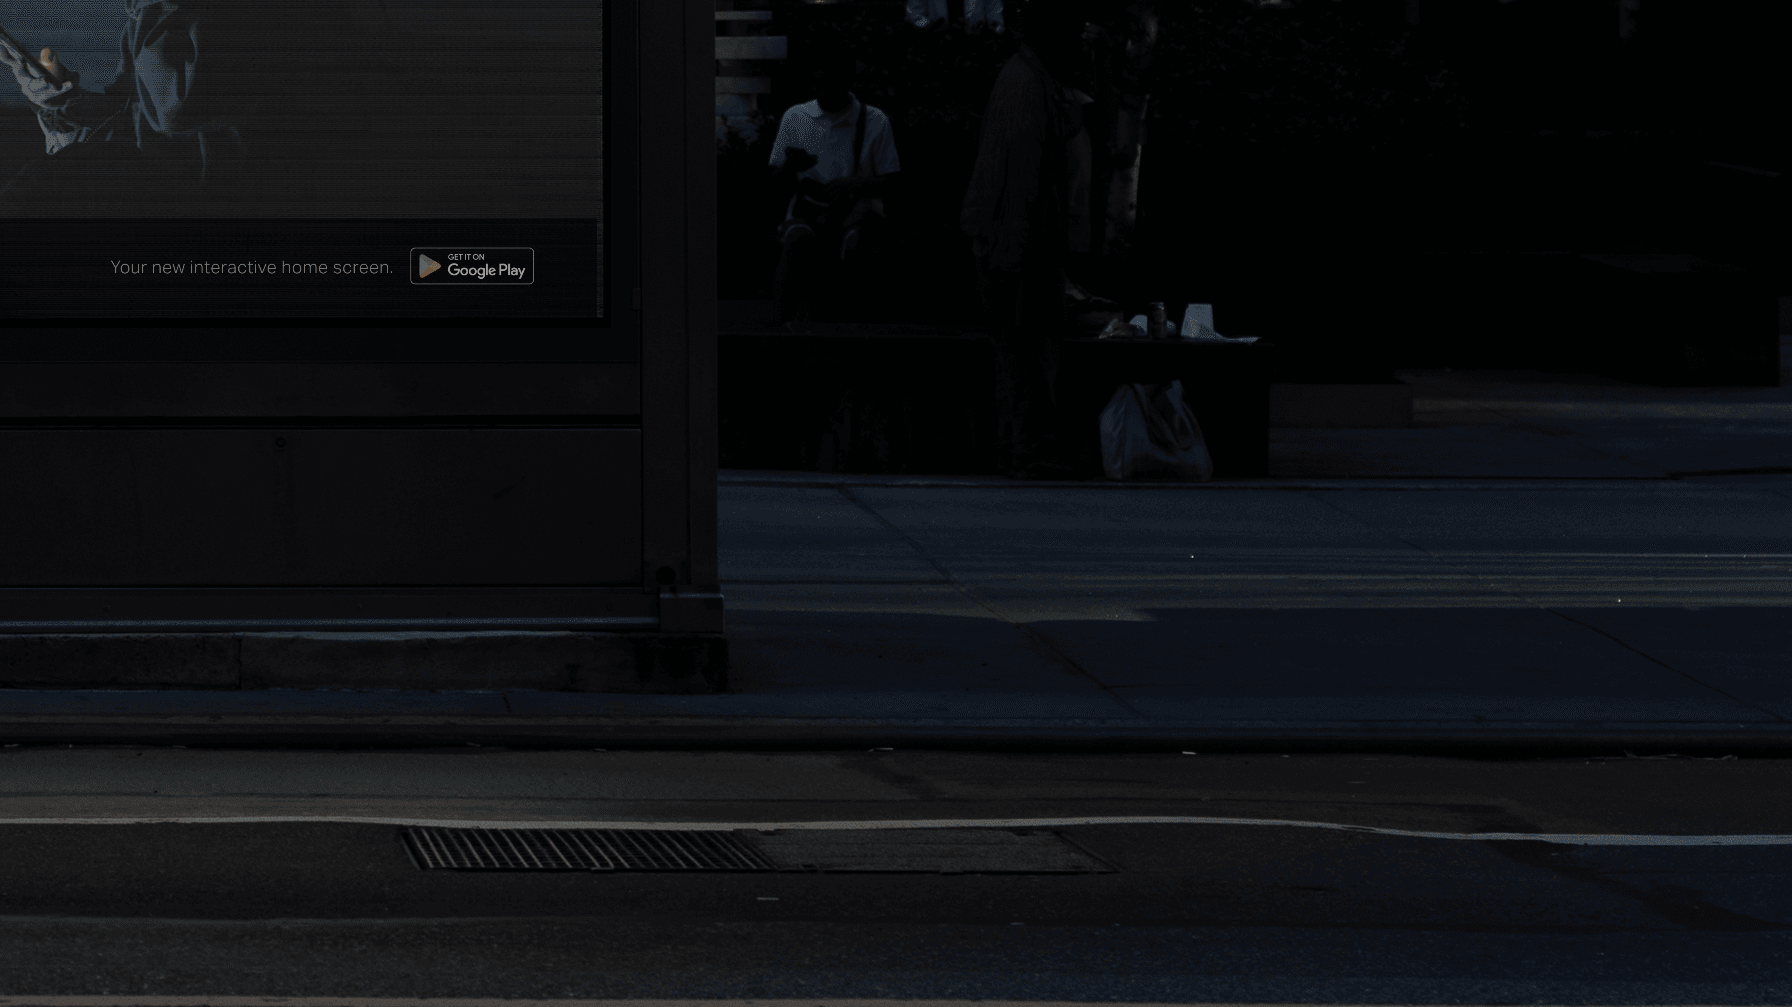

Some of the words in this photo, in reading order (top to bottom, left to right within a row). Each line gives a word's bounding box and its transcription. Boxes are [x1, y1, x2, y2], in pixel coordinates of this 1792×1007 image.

[447, 253, 463, 261] GET
[464, 253, 471, 261] IT
[472, 253, 485, 261] ON
[110, 261, 147, 275] Your
[152, 264, 186, 275] new
[190, 260, 277, 275] interactive
[282, 260, 328, 275] home
[333, 263, 394, 275] screen.
[447, 263, 496, 280] Google
[498, 263, 526, 280] Play
